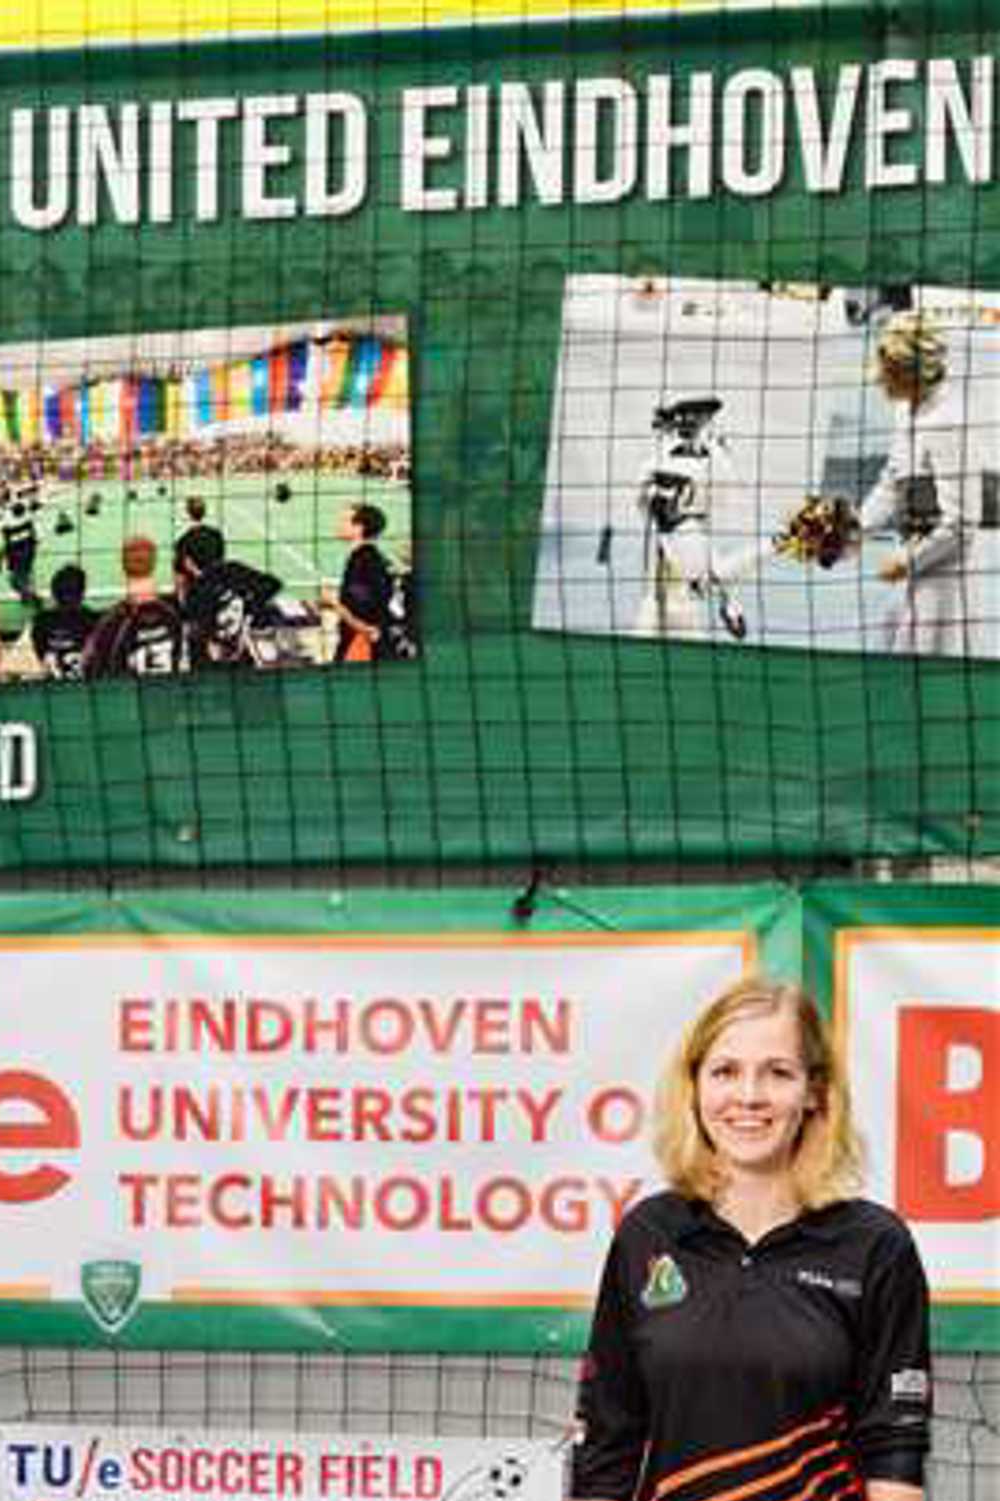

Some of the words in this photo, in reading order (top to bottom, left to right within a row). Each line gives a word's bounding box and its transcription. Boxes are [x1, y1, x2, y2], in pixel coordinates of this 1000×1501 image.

[9, 92, 368, 231] UNITED
[402, 55, 995, 212] EINDHOVEN
[118, 998, 572, 1055] EINDHOVEN
[118, 1086, 564, 1143] UNIVERSITY
[587, 1087, 644, 1143] O
[117, 1173, 644, 1234] TECHNOLOGY
[8, 1439, 122, 1498] TU/e
[129, 1447, 304, 1500] SOCCER
[319, 1454, 444, 1500] FIELD
